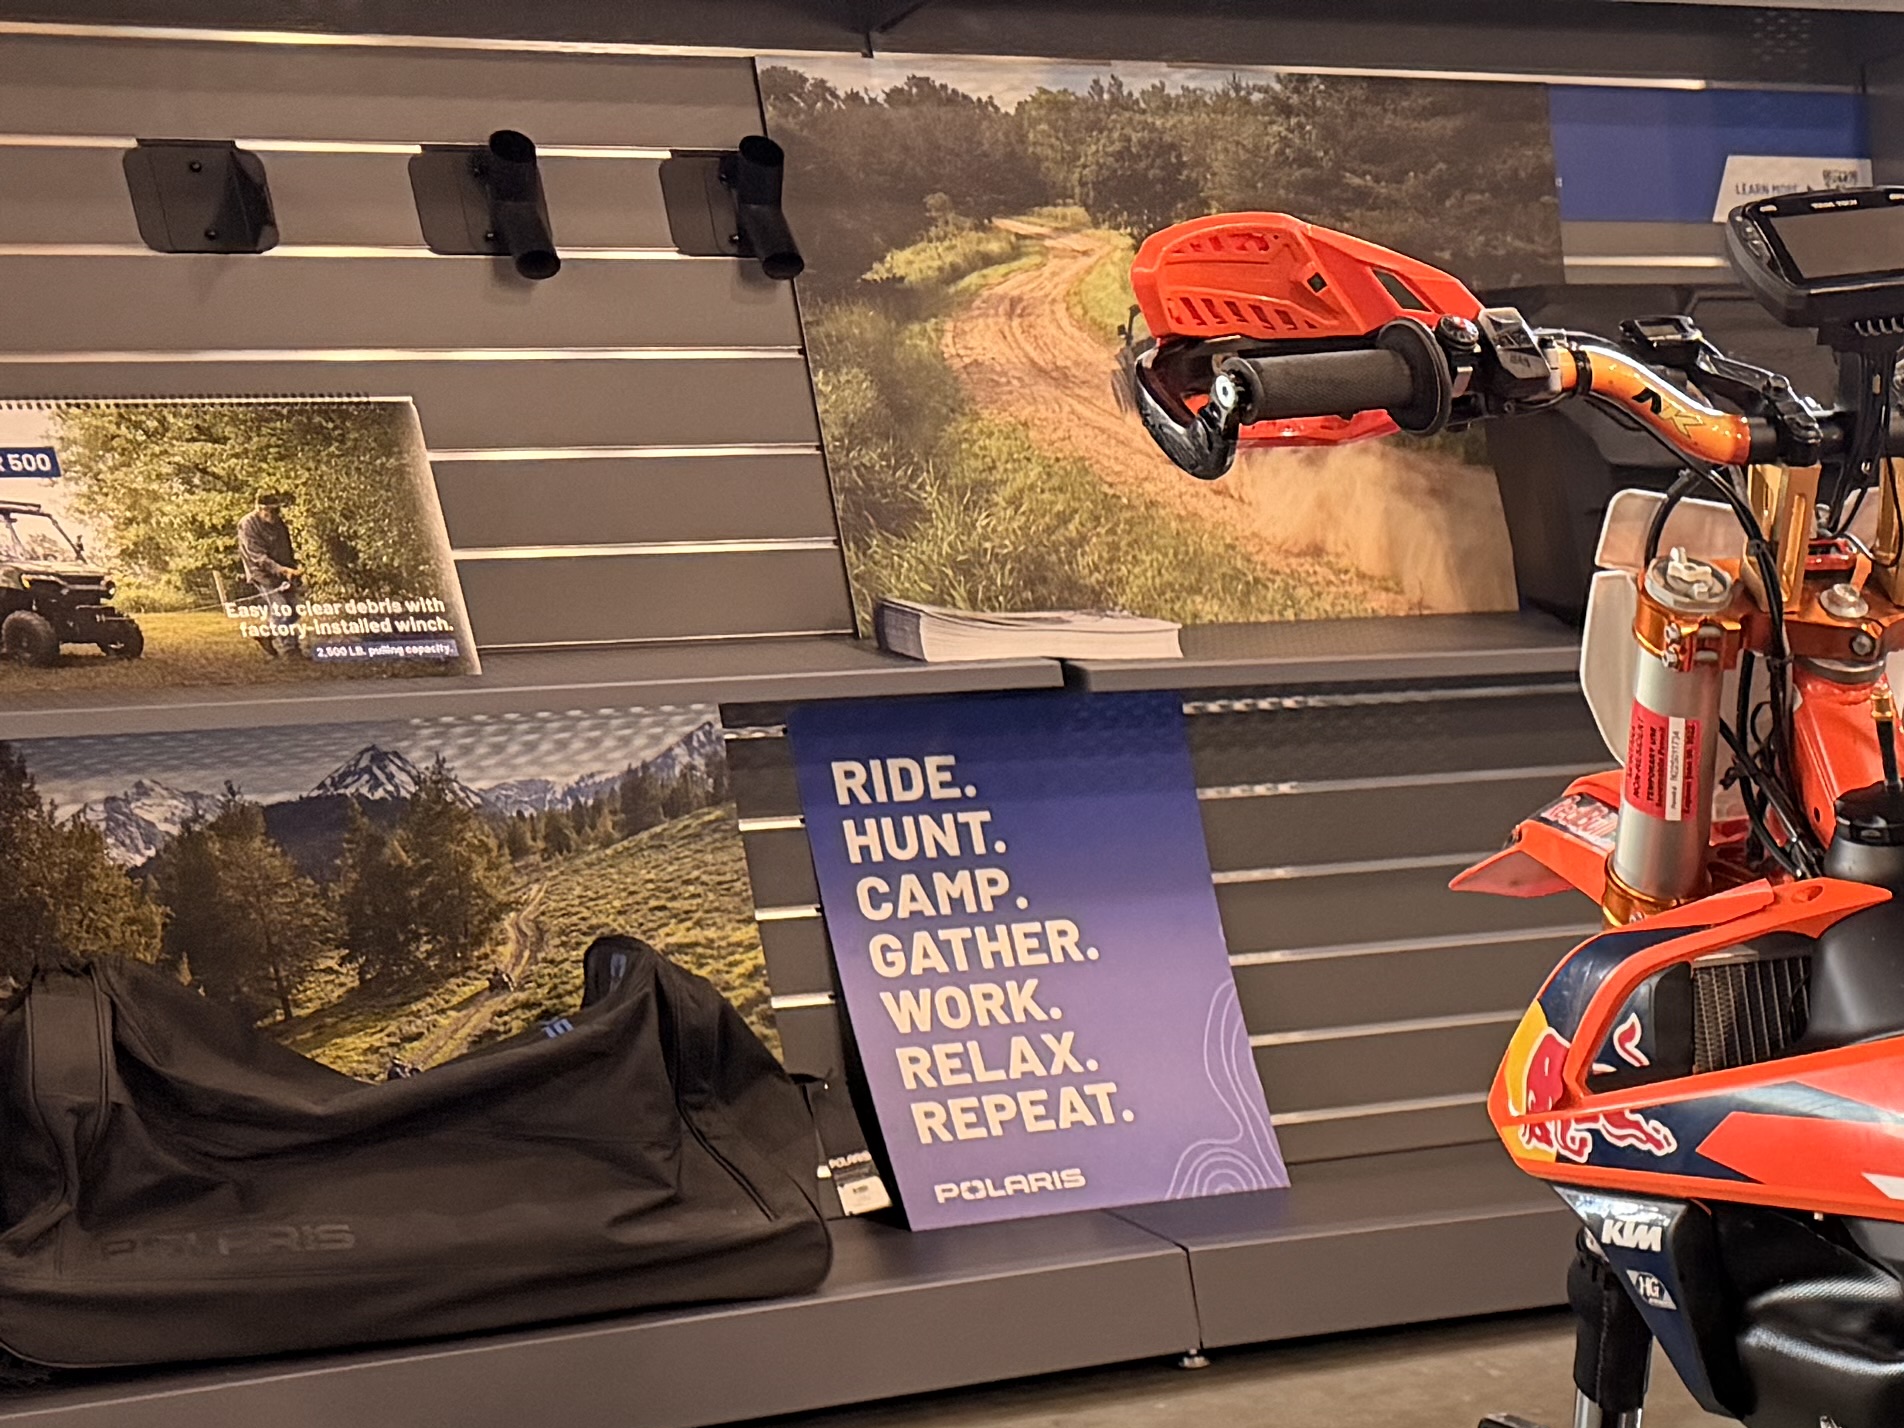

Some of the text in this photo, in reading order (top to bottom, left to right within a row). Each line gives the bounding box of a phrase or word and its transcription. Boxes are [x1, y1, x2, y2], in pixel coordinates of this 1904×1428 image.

[1735, 182, 1770, 196] LEARN
[7, 453, 52, 472] 500
[224, 596, 446, 621] Easy to clear debris with
[239, 615, 455, 640] factory-installed winch.
[831, 755, 977, 805] RIDE.
[842, 810, 1007, 863] HUNT.
[856, 867, 1029, 921] CAMP.
[868, 917, 1100, 979] GATHER.
[879, 977, 1063, 1034] WORK.
[895, 1031, 1099, 1090] RELAX.
[910, 1081, 1135, 1145] REPEAT.
[934, 1167, 1087, 1204] POLARIS
[101, 1222, 356, 1258] PARIS
[1601, 1218, 1663, 1252] KTM
